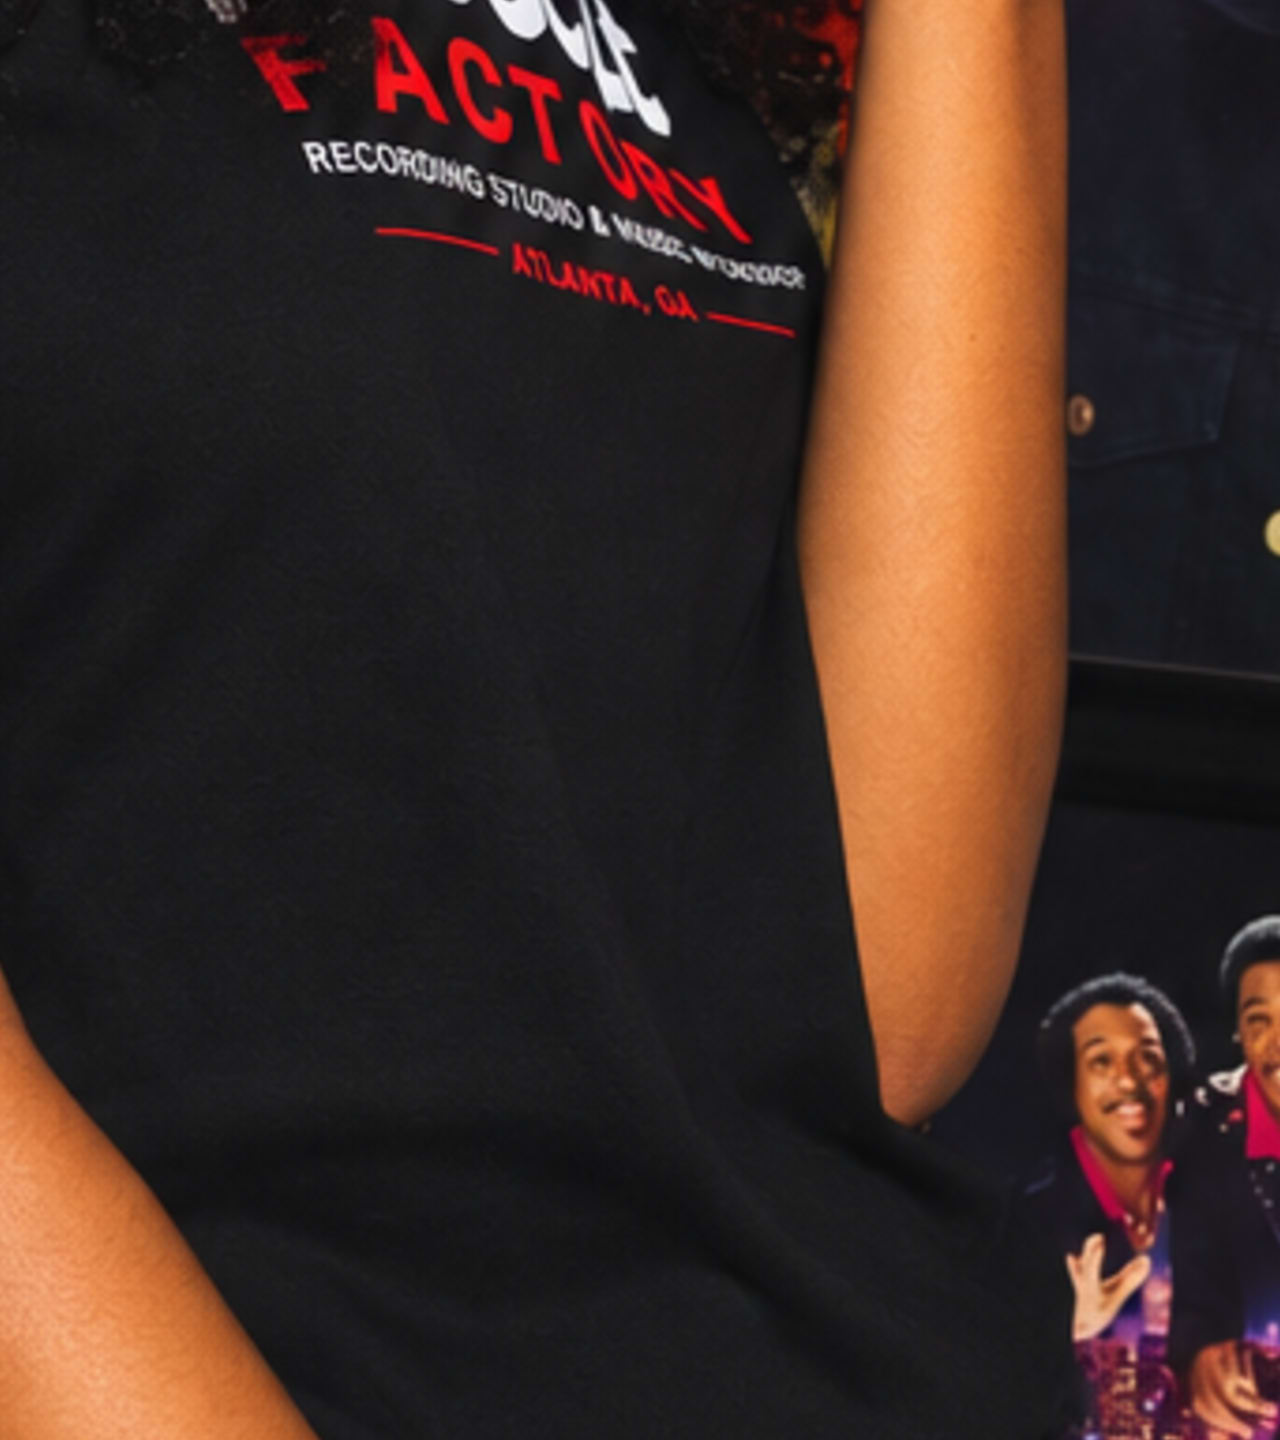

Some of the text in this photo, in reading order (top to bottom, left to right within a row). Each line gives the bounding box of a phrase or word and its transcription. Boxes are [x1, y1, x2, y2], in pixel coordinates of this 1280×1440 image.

[240, 17, 752, 244] FACTORY
[301, 140, 486, 201] RECORDING
[487, 173, 585, 231] STUDIO
